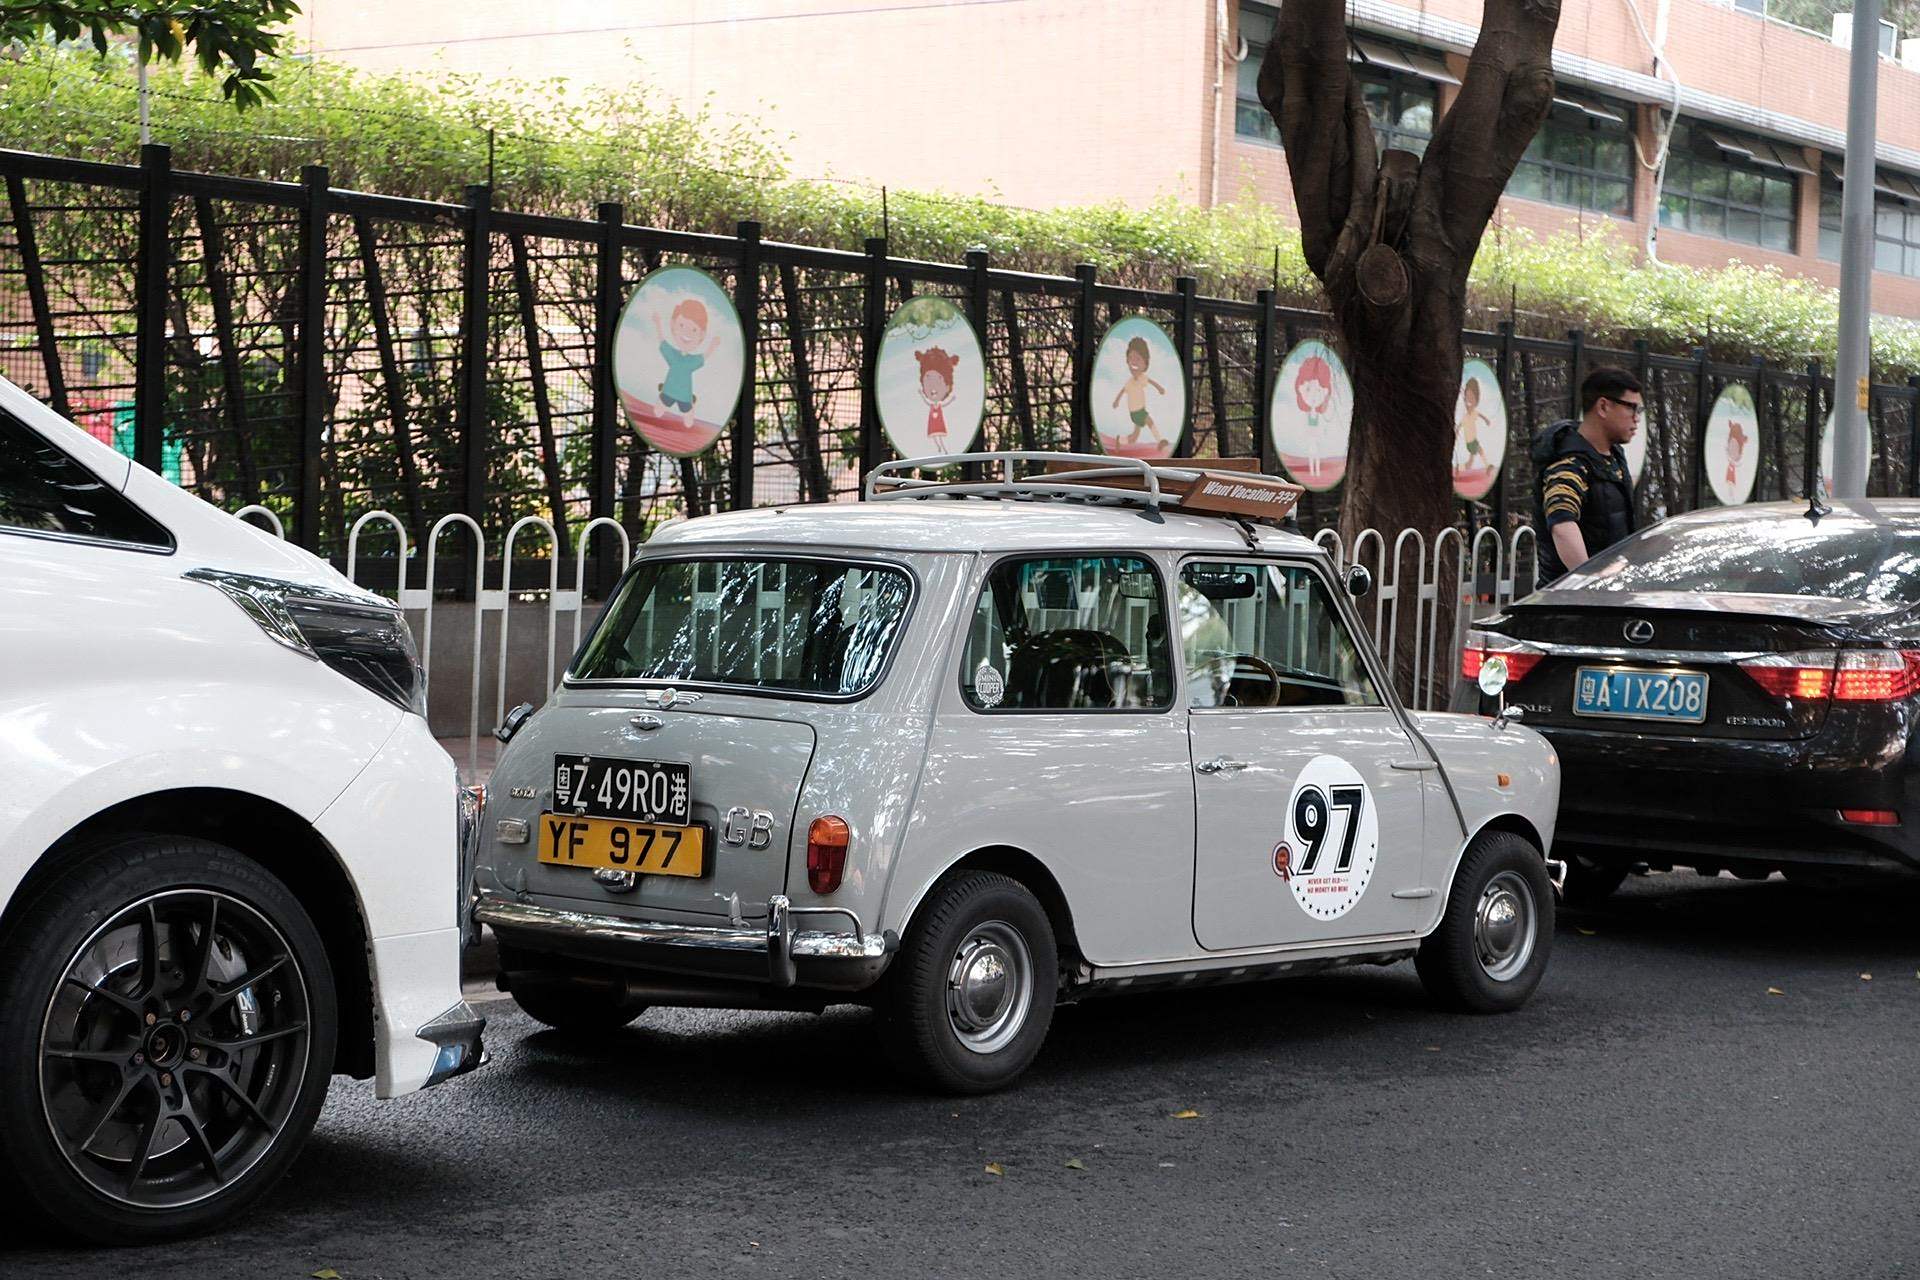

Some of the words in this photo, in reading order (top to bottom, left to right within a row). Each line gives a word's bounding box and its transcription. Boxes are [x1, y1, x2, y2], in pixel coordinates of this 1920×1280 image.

[1202, 480, 1234, 497] Want
[1229, 484, 1277, 503] Vacation
[1272, 490, 1297, 504] ???
[548, 820, 589, 860] YF
[609, 826, 682, 869] 977
[724, 806, 774, 851] GB
[1292, 783, 1365, 876] 97
